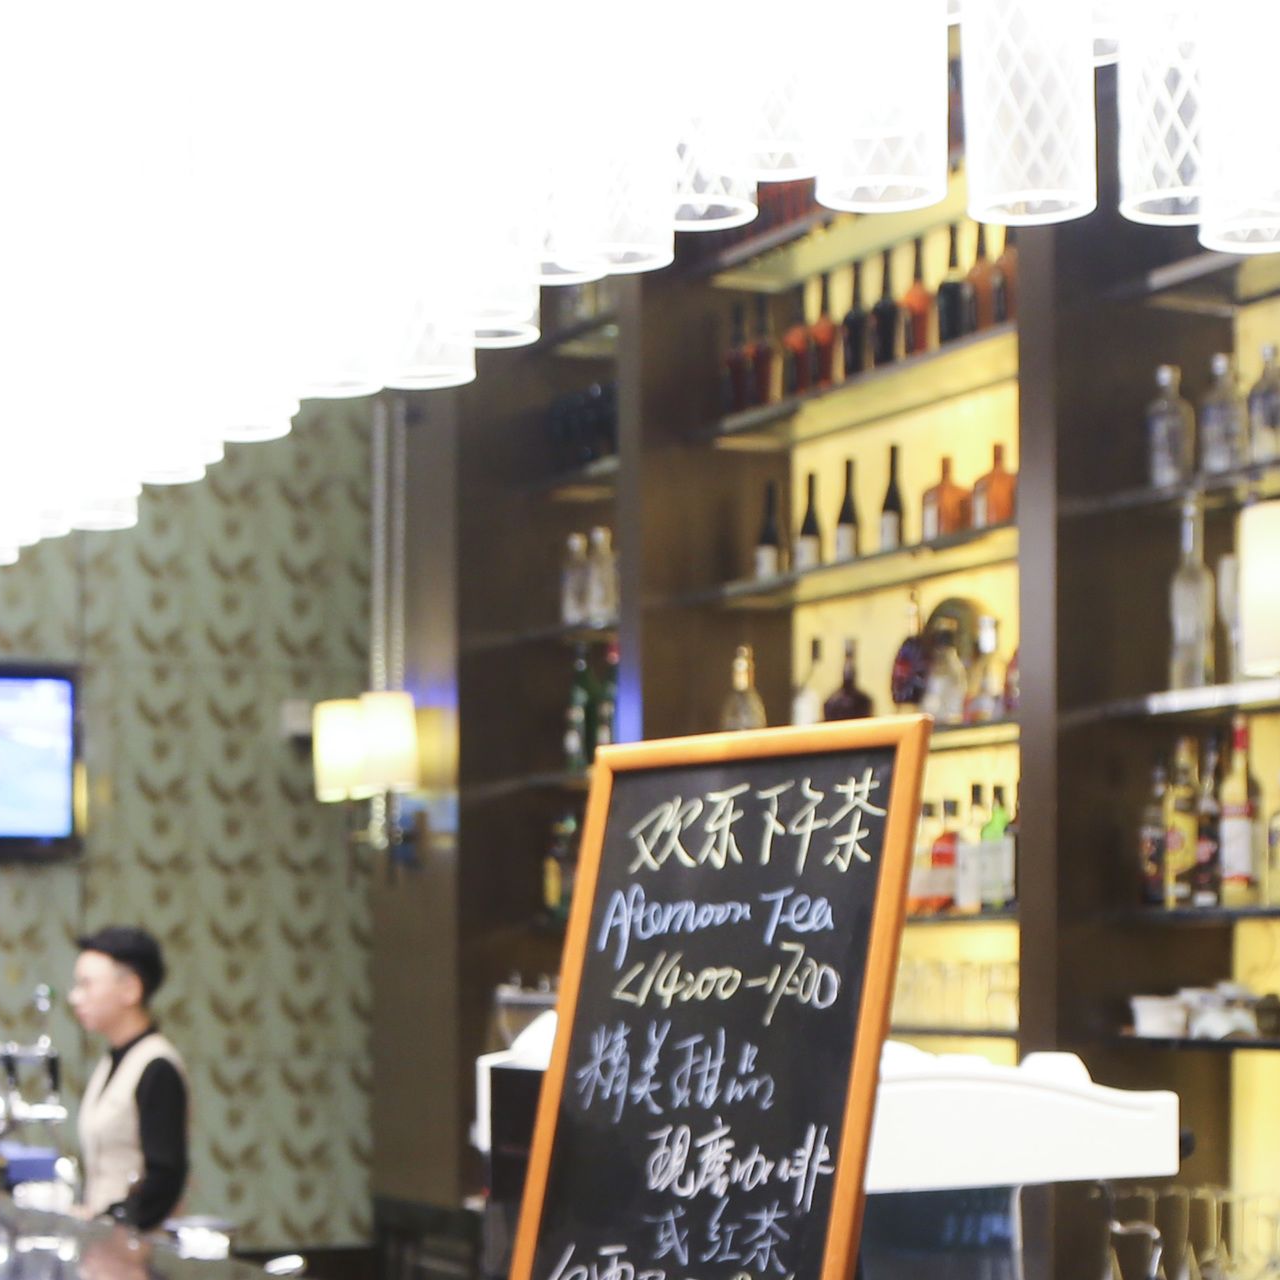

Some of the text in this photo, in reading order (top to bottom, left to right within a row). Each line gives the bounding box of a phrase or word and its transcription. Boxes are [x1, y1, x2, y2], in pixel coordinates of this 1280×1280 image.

[627, 767, 888, 876] 欢乐下午茶
[758, 886, 835, 945] Tea
